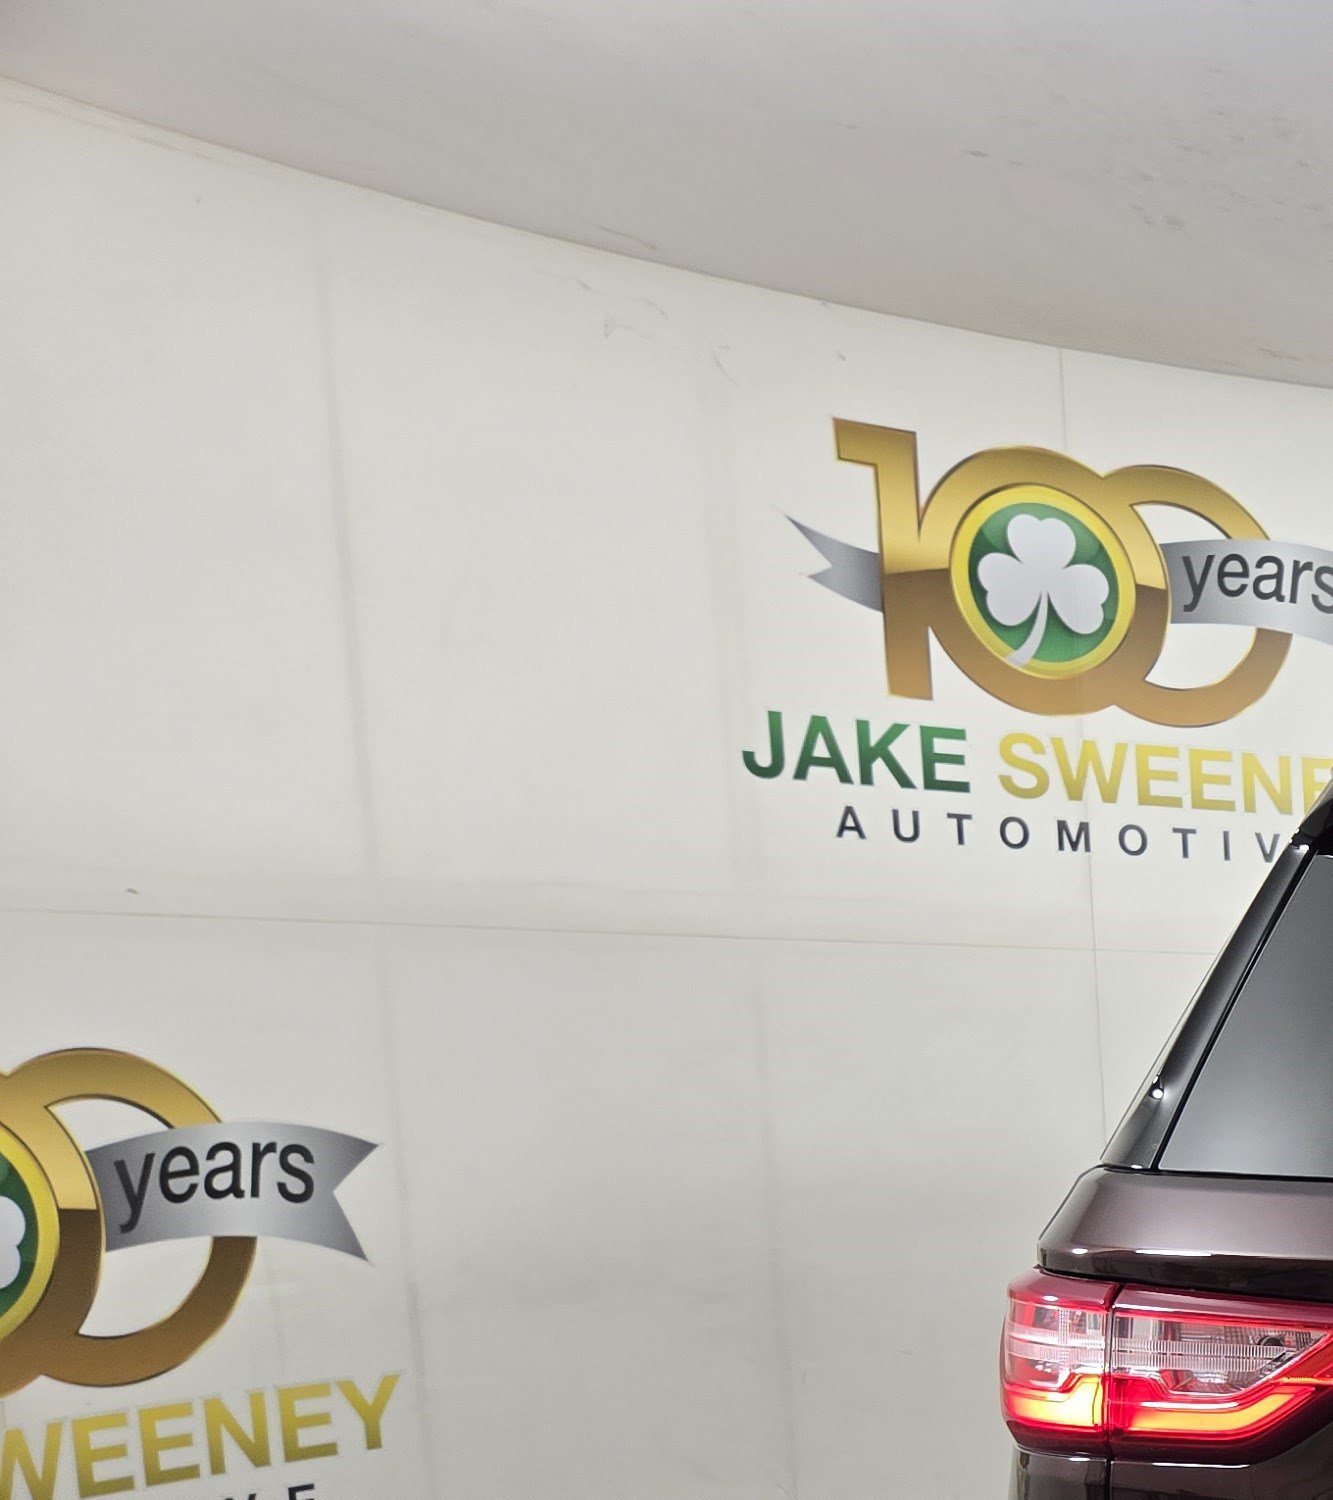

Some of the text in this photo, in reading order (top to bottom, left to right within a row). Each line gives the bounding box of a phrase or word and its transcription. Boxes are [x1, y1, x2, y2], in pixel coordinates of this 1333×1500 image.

[832, 416, 1293, 728] 100
[742, 711, 971, 794] JAKE
[836, 805, 1281, 864] AUTOMOTIV
[113, 1140, 315, 1234] years
